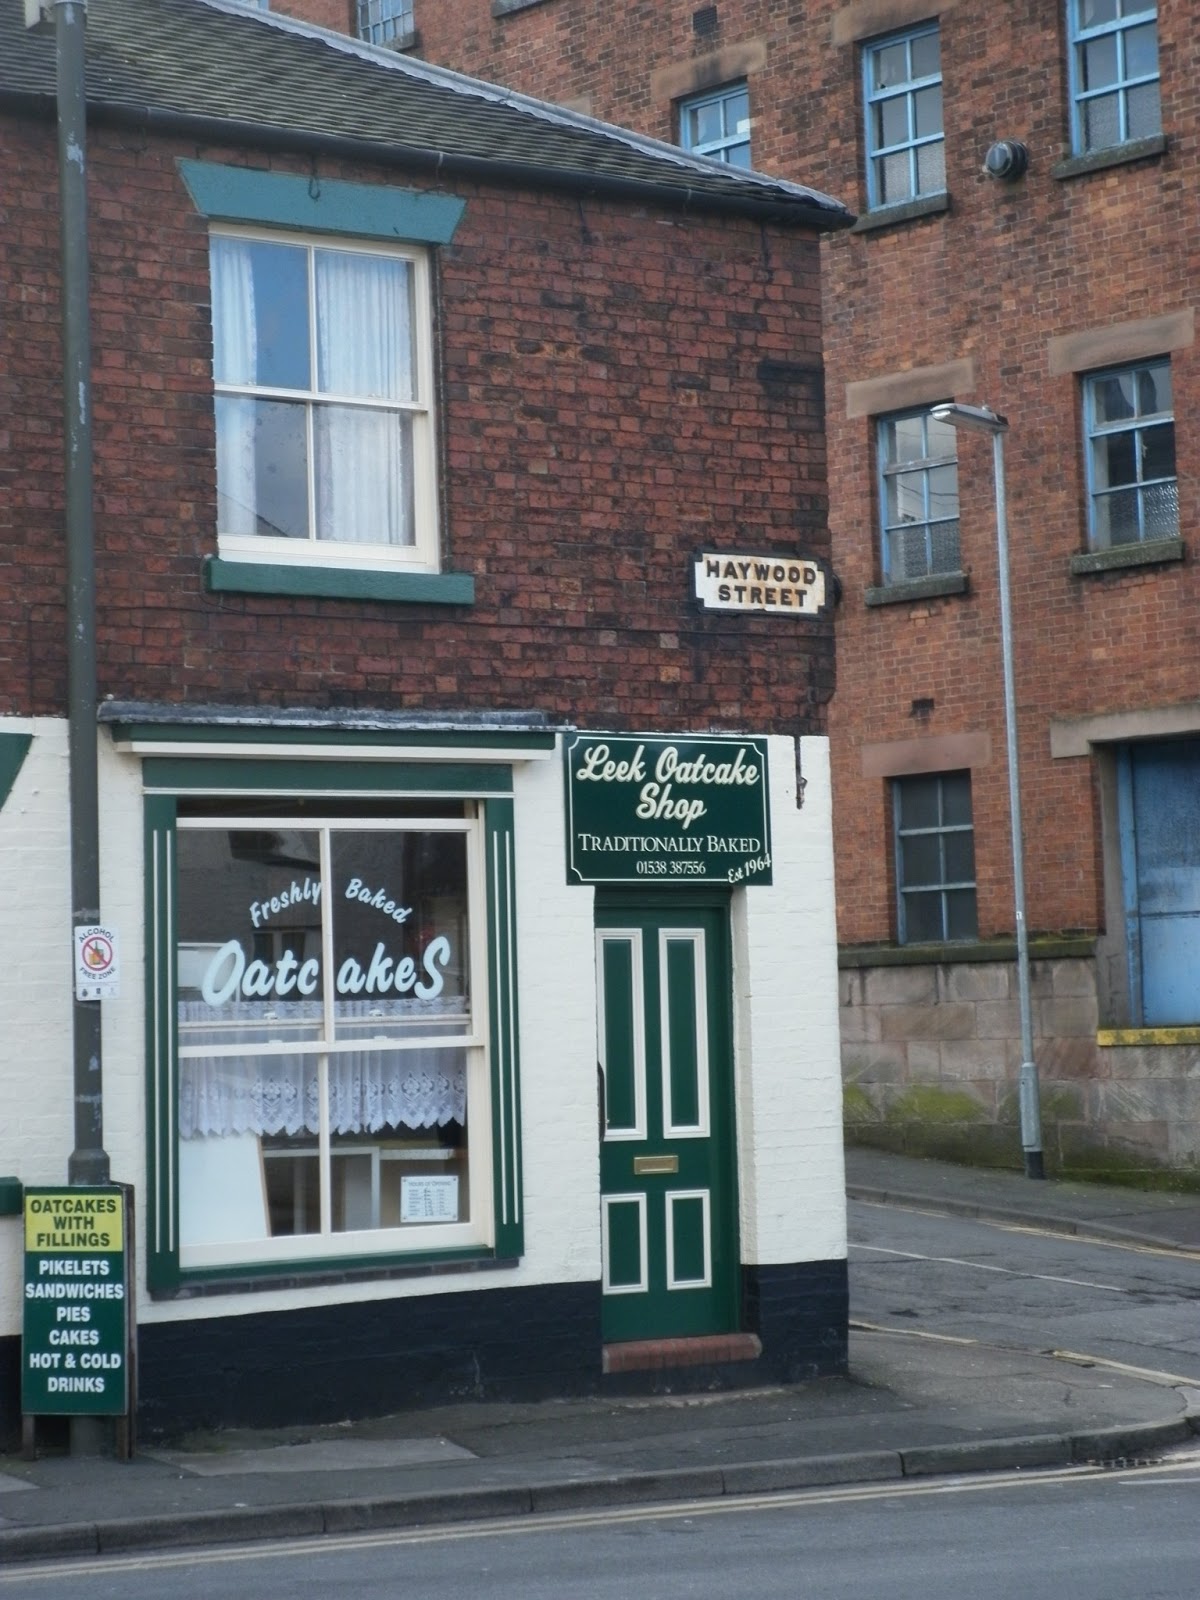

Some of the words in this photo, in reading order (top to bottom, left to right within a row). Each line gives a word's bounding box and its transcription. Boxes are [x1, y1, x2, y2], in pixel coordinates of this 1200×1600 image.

[706, 560, 816, 584] HAYWOOD
[718, 585, 807, 606] STREET
[576, 744, 646, 782] Leek
[655, 746, 760, 785] Oatcake
[636, 782, 707, 829] Shop
[636, 861, 667, 874] 01538
[669, 861, 706, 875] 387556
[728, 868, 743, 883] Est
[744, 853, 772, 877] 1964
[249, 877, 322, 928] Freshly
[345, 878, 413, 924] Baked
[79, 928, 114, 943] ALCOHOL
[80, 967, 96, 979] FREE
[98, 966, 116, 980] ZONE
[30, 1199, 116, 1213] OATCAKES
[53, 1216, 94, 1230] WITH
[36, 1233, 110, 1247] FILLINGS
[39, 1260, 110, 1275] PIKELETS
[25, 1283, 124, 1299] SANDWICHES
[56, 1307, 91, 1322] PIES
[49, 1330, 99, 1345] CAKES
[29, 1353, 60, 1369] HOT
[65, 1353, 77, 1369] &
[80, 1353, 121, 1369] COLD
[47, 1377, 105, 1393] DRINKS
